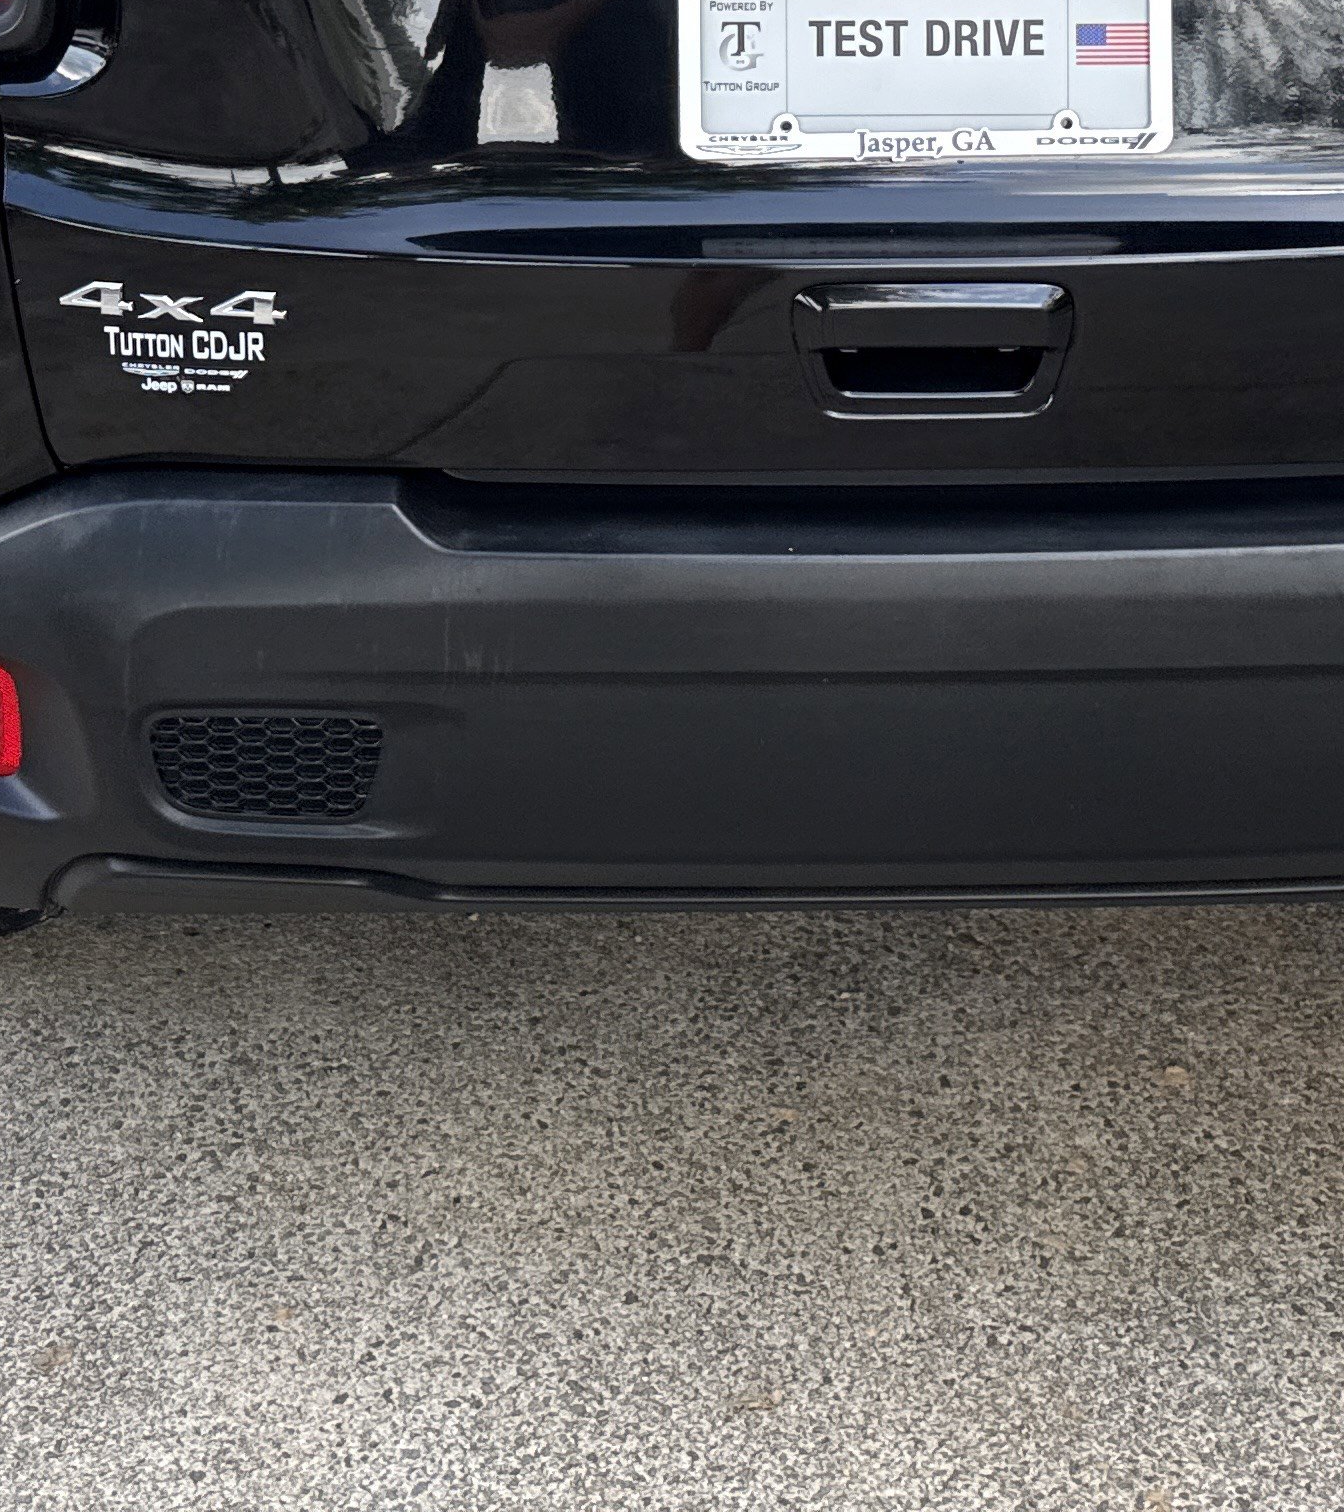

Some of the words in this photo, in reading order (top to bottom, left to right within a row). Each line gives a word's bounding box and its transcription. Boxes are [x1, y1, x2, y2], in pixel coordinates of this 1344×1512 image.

[808, 19, 909, 57] TEST
[925, 19, 1045, 57] DRIVE
[856, 131, 944, 159] Jasper,
[951, 130, 997, 152] GA
[1036, 136, 1142, 147] DODGE
[59, 280, 288, 325] 4x4
[103, 325, 184, 359] TUTTON
[192, 329, 266, 362] CDJR
[140, 377, 178, 394] Jeep
[195, 383, 231, 392] RAM
